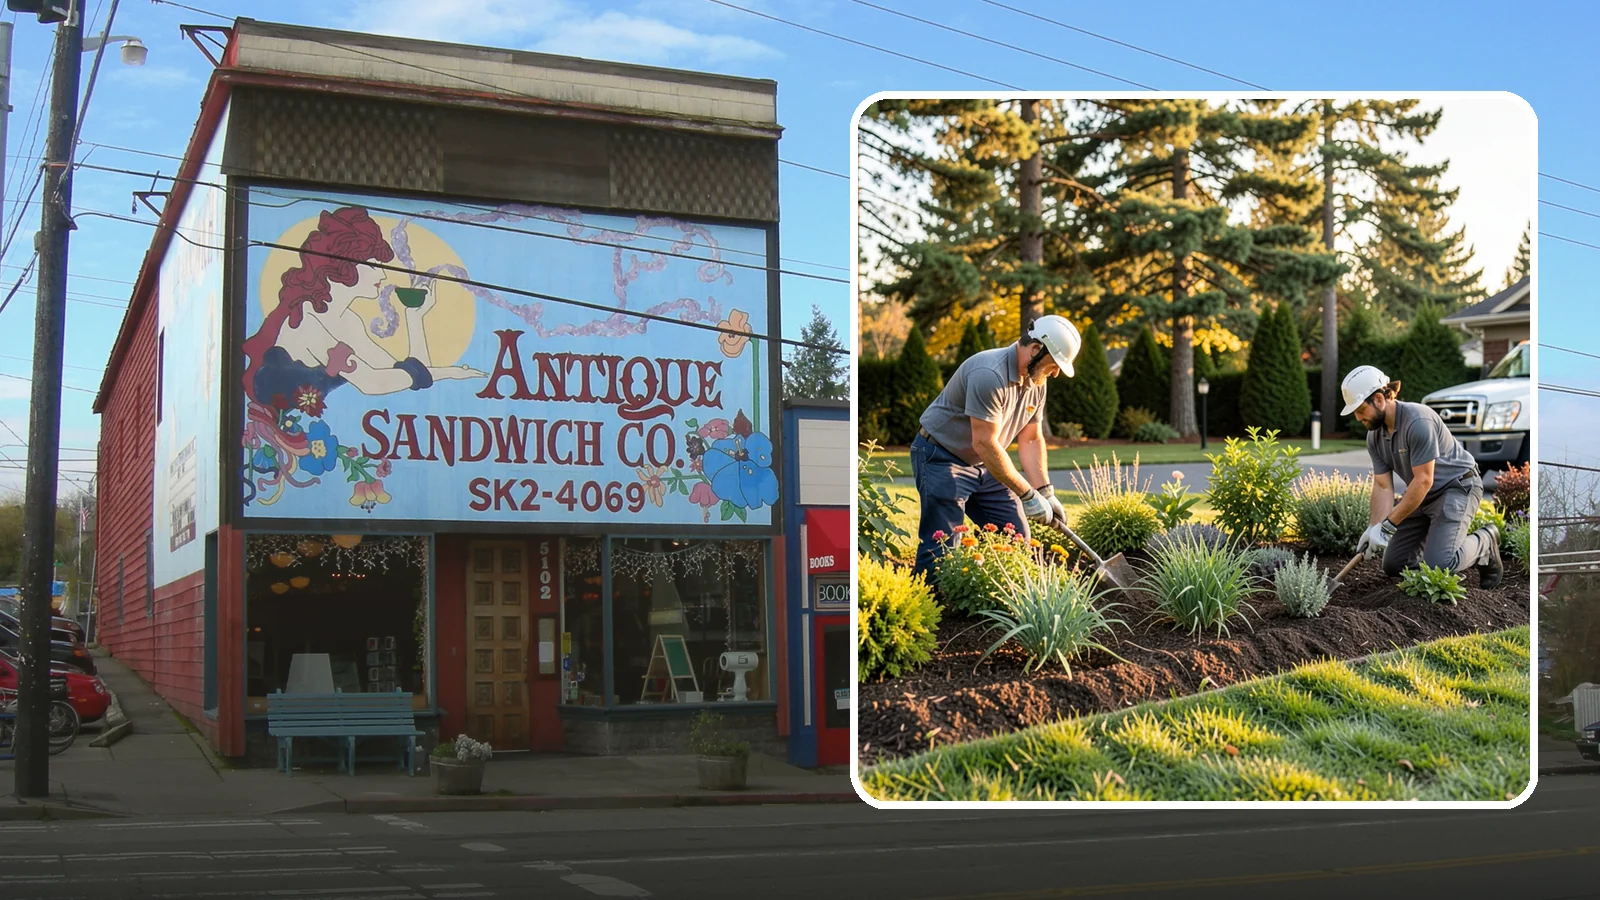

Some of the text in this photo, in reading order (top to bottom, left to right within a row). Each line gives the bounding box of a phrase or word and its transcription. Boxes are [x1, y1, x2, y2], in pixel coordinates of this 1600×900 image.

[476, 329, 723, 421] ANTIQUE
[361, 408, 685, 469] SANDWICH CO.
[468, 477, 645, 513] SK2-4069
[540, 542, 551, 600] 5102
[809, 555, 835, 569] BOOKS
